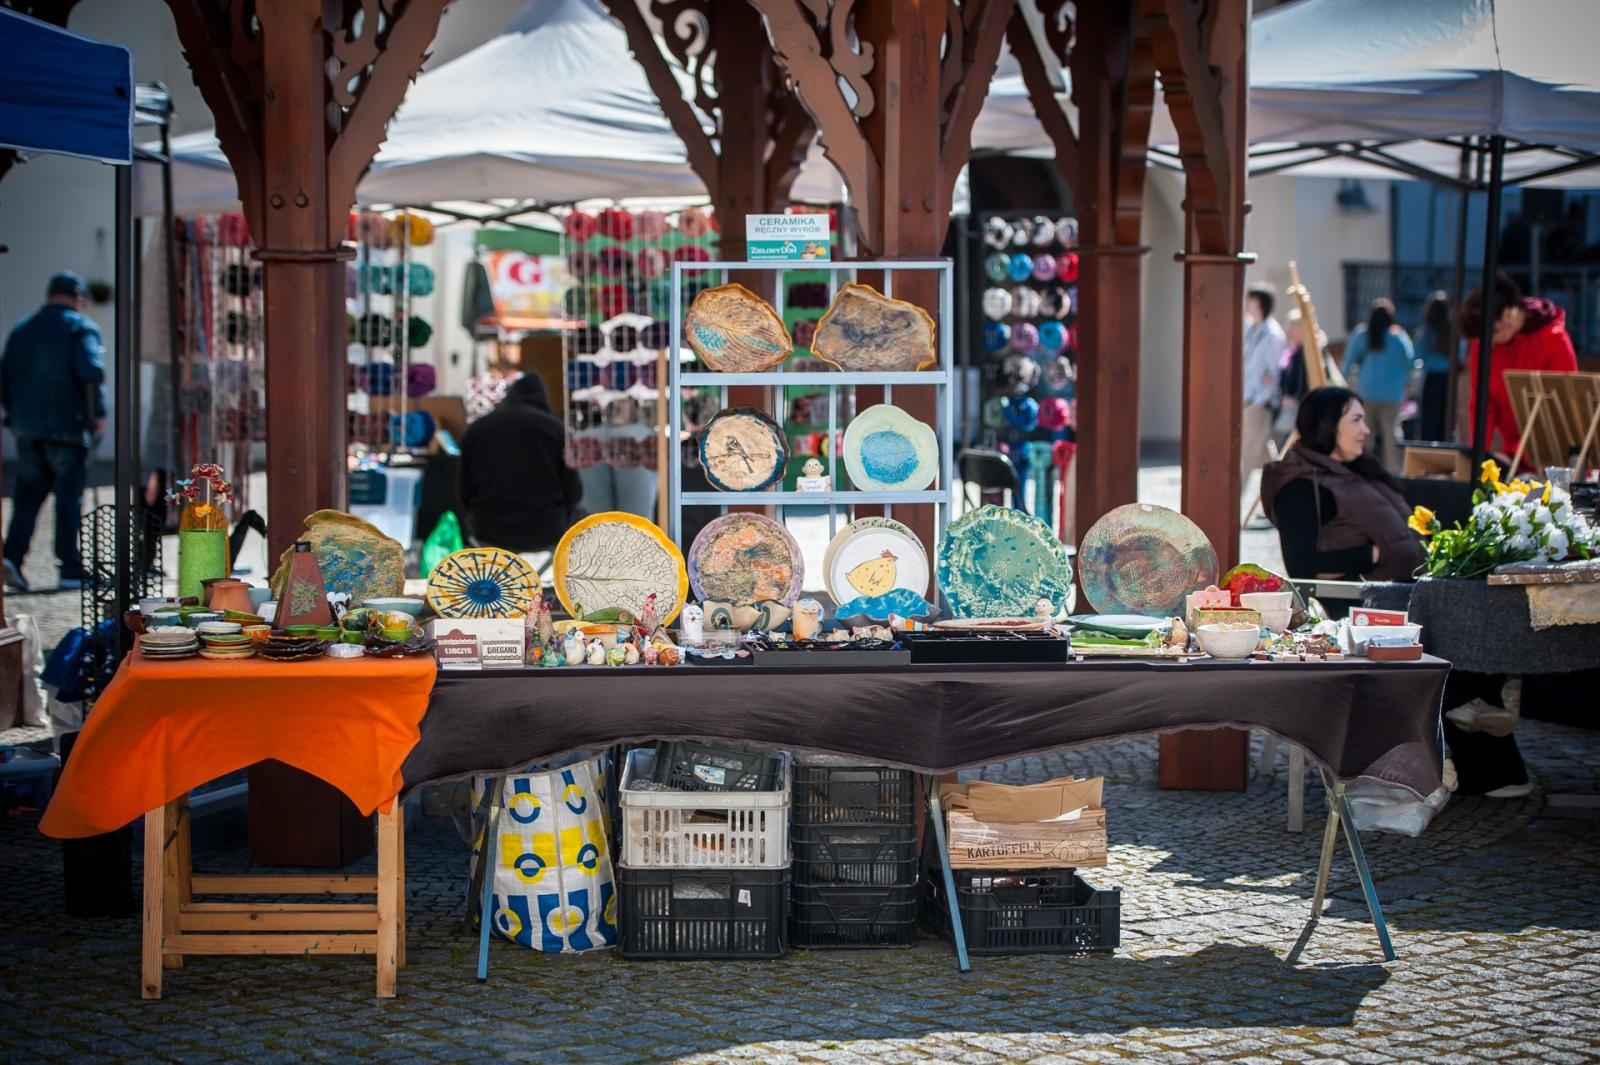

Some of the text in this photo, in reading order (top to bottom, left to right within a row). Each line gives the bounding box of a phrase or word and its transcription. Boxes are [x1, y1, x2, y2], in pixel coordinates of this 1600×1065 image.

[759, 217, 816, 226] CERAMIKA
[754, 225, 821, 234] RĘCZNY WYRÓB
[487, 646, 518, 654] OREGANO
[966, 841, 1042, 859] KARTOFFELN
